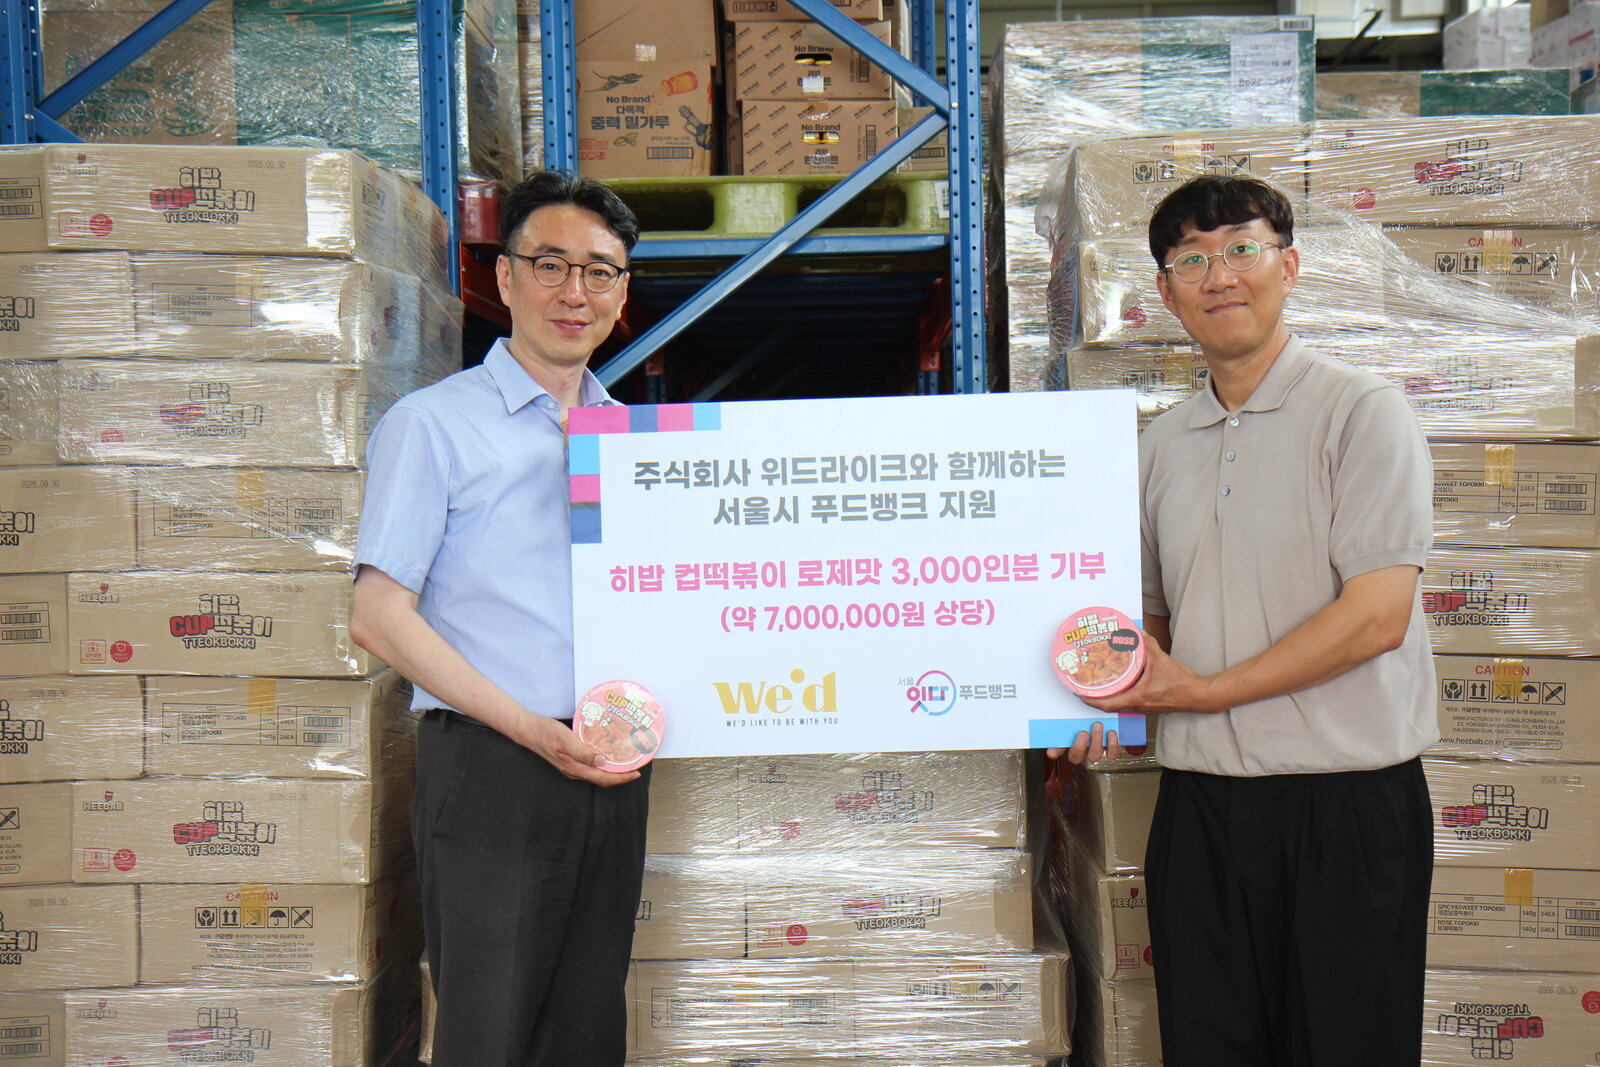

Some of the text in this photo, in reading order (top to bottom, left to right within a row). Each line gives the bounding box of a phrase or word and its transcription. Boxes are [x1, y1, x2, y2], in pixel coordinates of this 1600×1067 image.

[606, 95, 651, 104] No Brand
[616, 106, 645, 114] 다목적
[591, 115, 670, 130] 중력 밀가루
[179, 166, 222, 189] 히밥
[163, 212, 239, 224] TTEOKBOKKI
[634, 449, 1066, 490] 주식회사 위드라이크와 함께하는
[713, 490, 996, 526] 서울시 푸드뱅크 지원
[610, 552, 1106, 593] 히밥 컵떡볶이 로제맛 3,000인분 기부
[200, 594, 240, 615] 히밥
[720, 599, 996, 633] (약 7,000,000원 상당)
[1076, 613, 1099, 628] 히밥
[1433, 614, 1510, 626] TTEOKBOKKI
[170, 615, 272, 637] CUP떡볶이
[182, 636, 256, 650] TTEOKBOKKI
[1475, 664, 1530, 676] CAUTION
[898, 676, 914, 686] 서울
[960, 684, 1018, 700] 푸드뱅크
[726, 720, 746, 728] WE'D
[786, 718, 796, 726] BE
[800, 718, 820, 726] WITH
[823, 718, 838, 726] YOU
[1472, 784, 1514, 806] 히밥
[203, 801, 244, 822] 히밥
[1442, 805, 1548, 829] CUP떡볶이
[173, 821, 277, 844] CUP떡볶이
[1455, 828, 1531, 842] TTEOKBOKKI
[186, 844, 260, 856] TTEOKBOKKI
[855, 918, 926, 930] TTEOKBOKKI
[1455, 1002, 1530, 1016] TTEOKBOKKI
[1472, 1038, 1514, 1060] 히밥
